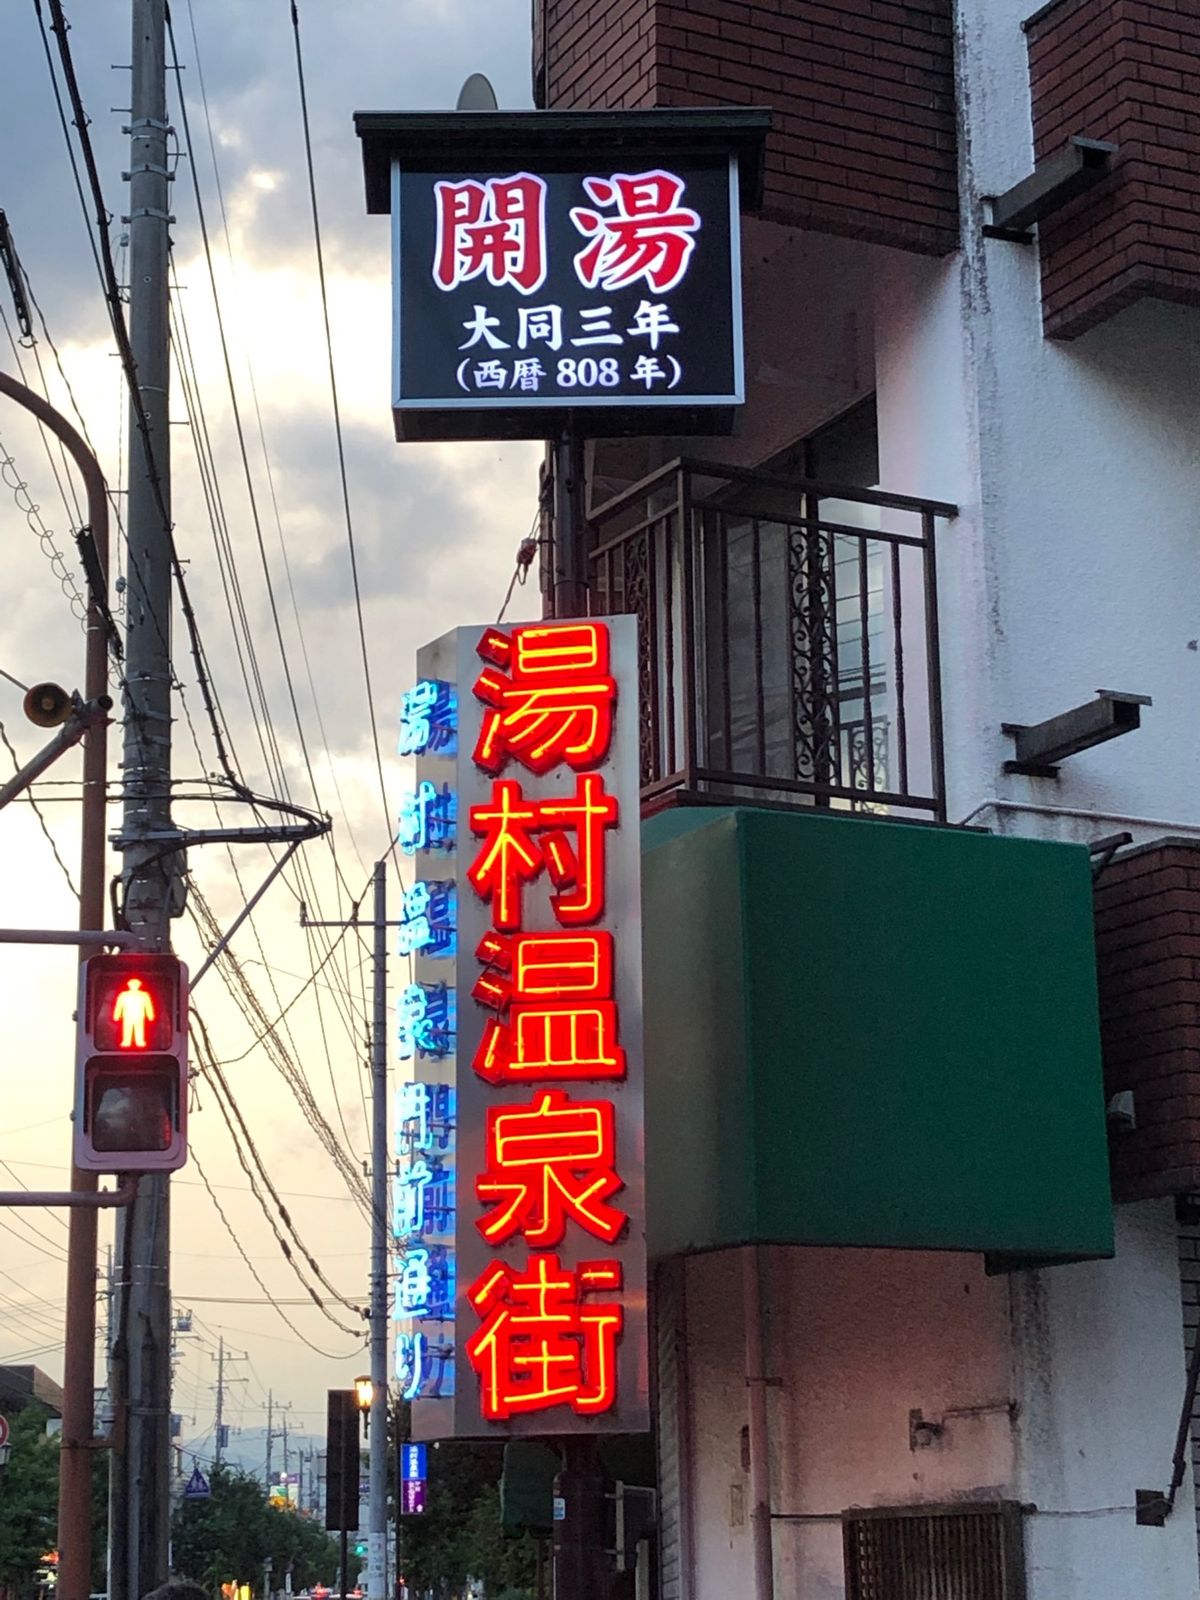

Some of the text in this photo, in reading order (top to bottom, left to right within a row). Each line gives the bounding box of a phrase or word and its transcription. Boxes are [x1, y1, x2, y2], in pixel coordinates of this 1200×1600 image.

[433, 170, 702, 295] 開湯
[458, 300, 681, 352] 大同三年
[465, 621, 626, 1420] 湯村温泉街
